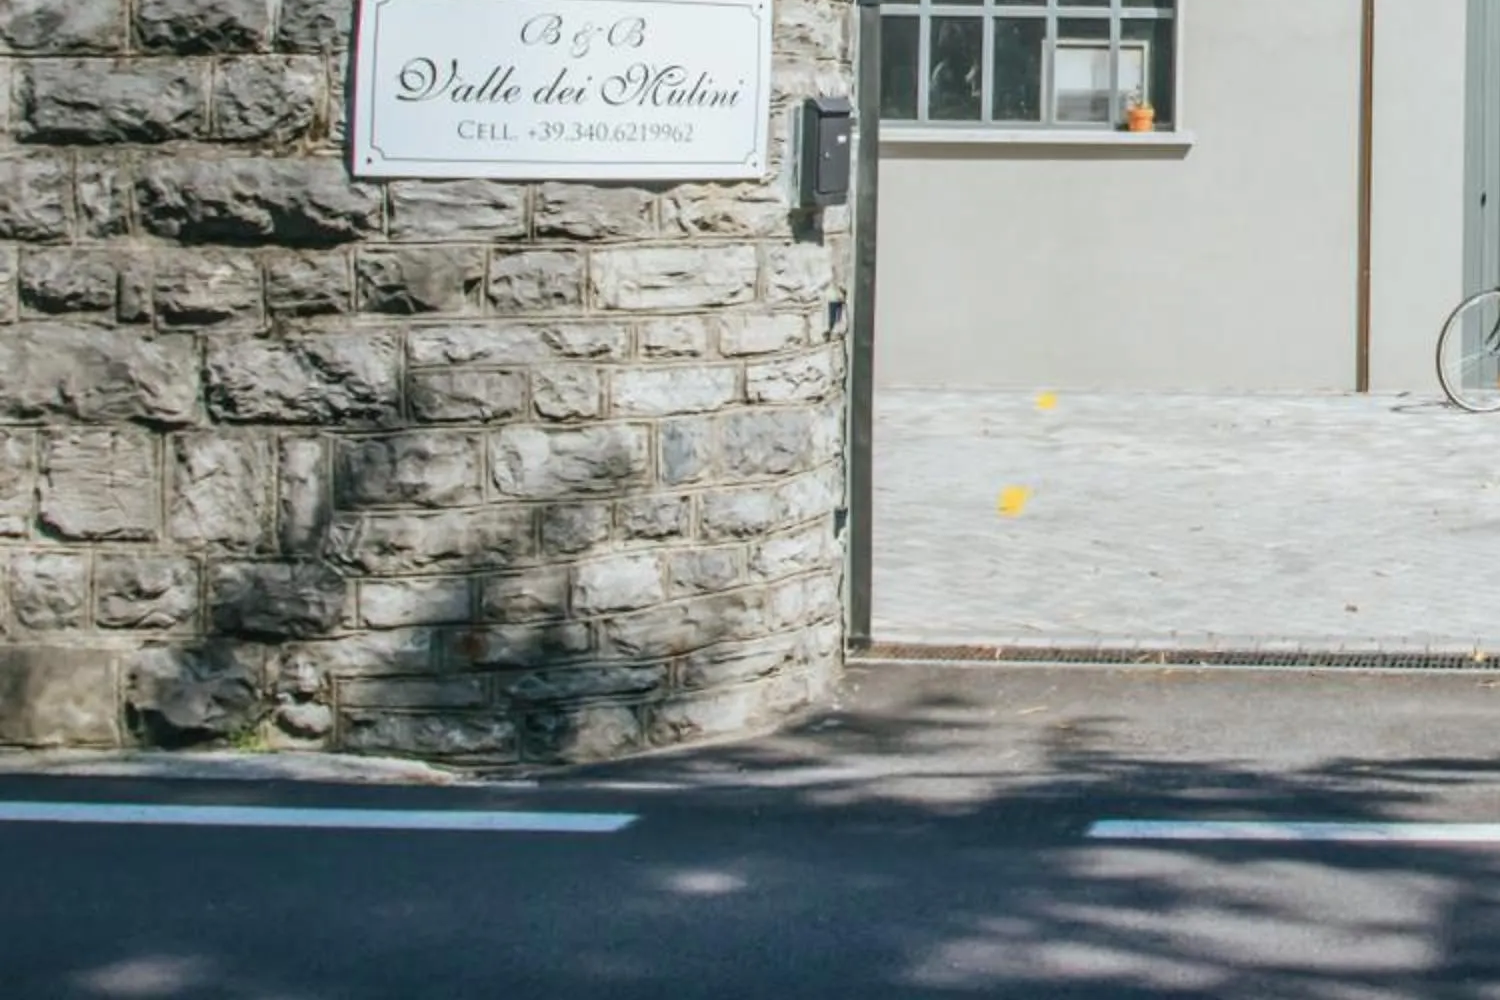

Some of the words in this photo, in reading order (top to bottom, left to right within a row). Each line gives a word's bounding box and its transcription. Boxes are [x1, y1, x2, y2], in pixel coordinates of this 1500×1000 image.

[520, 13, 564, 46] B
[571, 19, 604, 57] &
[607, 16, 648, 48] B
[396, 57, 521, 104] Valle
[532, 68, 594, 105] dei
[601, 62, 745, 108] Mulini
[528, 121, 694, 143] +39.340.6219962
